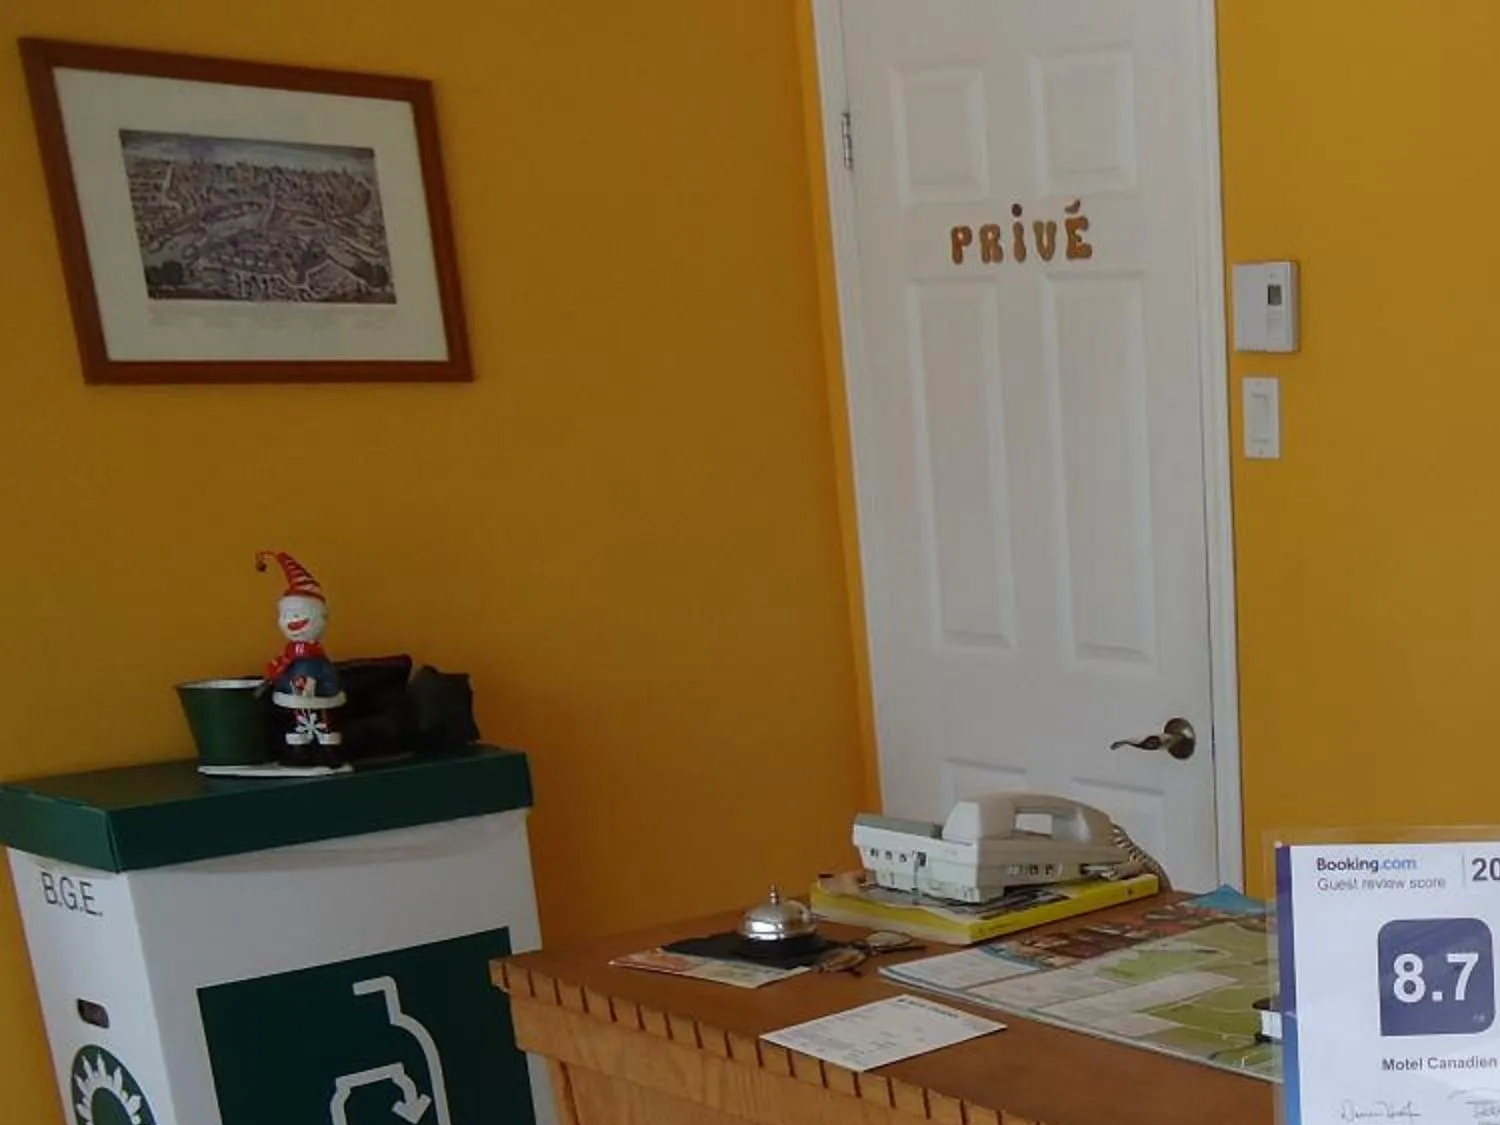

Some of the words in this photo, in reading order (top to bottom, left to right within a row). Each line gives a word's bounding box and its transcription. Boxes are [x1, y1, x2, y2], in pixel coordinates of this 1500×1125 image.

[1316, 857, 1417, 873] Booking.com
[1317, 877, 1359, 891] Guest
[1361, 878, 1406, 890] review
[1409, 878, 1446, 889] score
[42, 870, 103, 917] B.G.E.
[1392, 951, 1479, 1003] 8.7
[1381, 1057, 1423, 1071] Motel
[1427, 1056, 1498, 1070] Canadien
